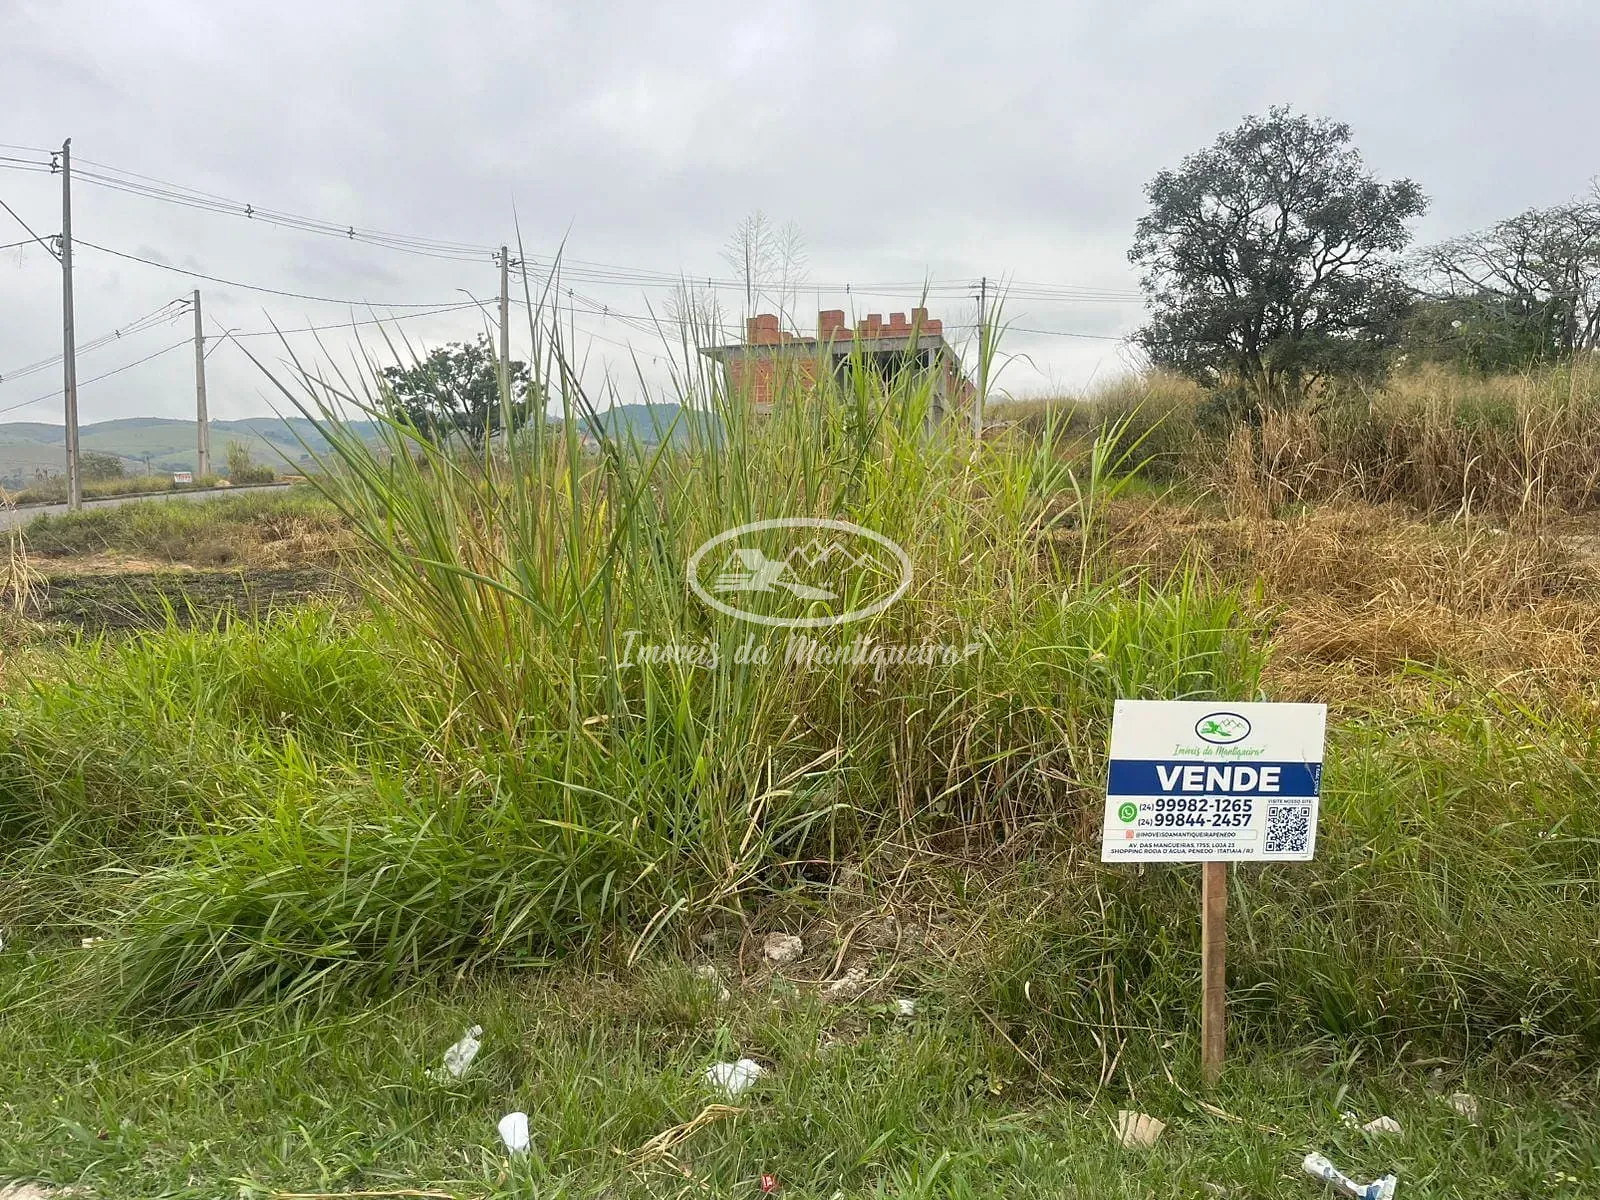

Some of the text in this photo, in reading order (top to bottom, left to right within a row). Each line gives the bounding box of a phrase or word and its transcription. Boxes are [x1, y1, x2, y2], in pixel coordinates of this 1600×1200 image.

[1203, 745, 1213, 756] da
[1155, 765, 1281, 793] VENDE
[1139, 798, 1253, 813] (24) 99982-1265
[1138, 813, 1252, 827] (24) 99844-2457
